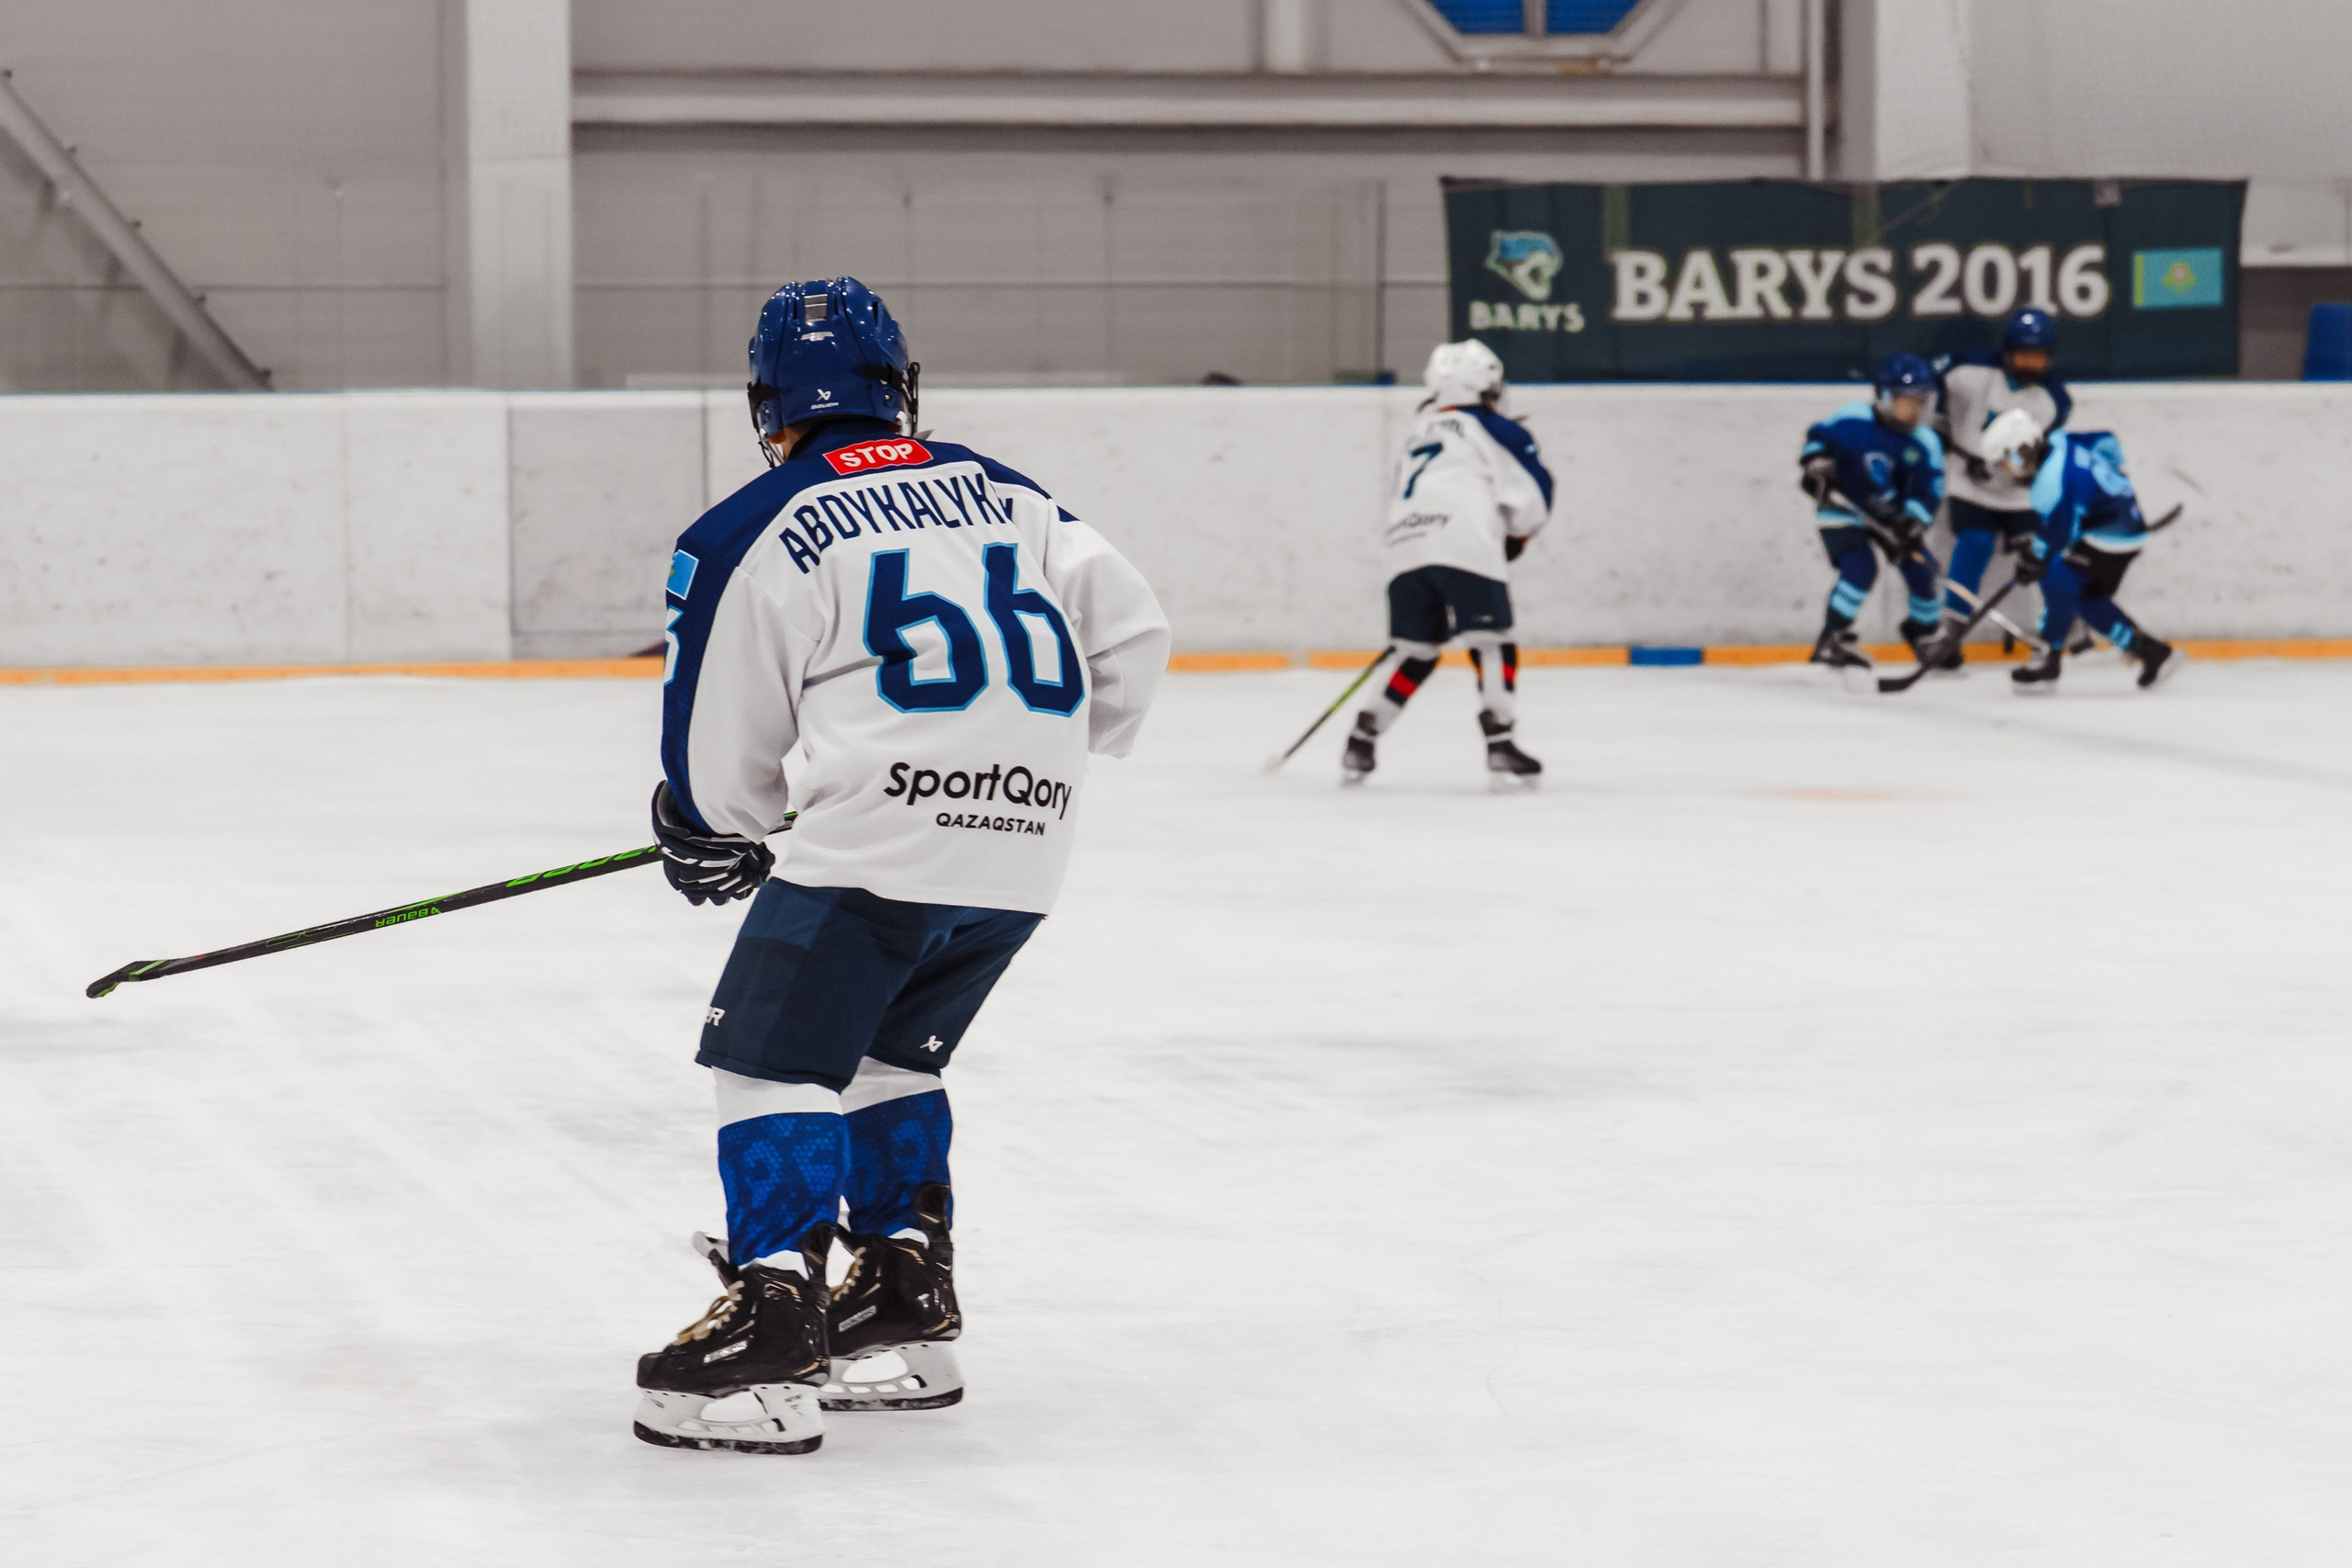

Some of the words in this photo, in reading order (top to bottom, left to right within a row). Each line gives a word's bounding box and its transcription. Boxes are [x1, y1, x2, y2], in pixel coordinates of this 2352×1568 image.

[1611, 249, 1896, 321] BARYS
[1911, 243, 2109, 317] 2016
[1471, 301, 1586, 333] BARYS
[839, 443, 913, 468] STOP
[863, 542, 1085, 717] 66
[883, 761, 1072, 820] SportQory
[935, 812, 1046, 836] QAZAQSTAN
